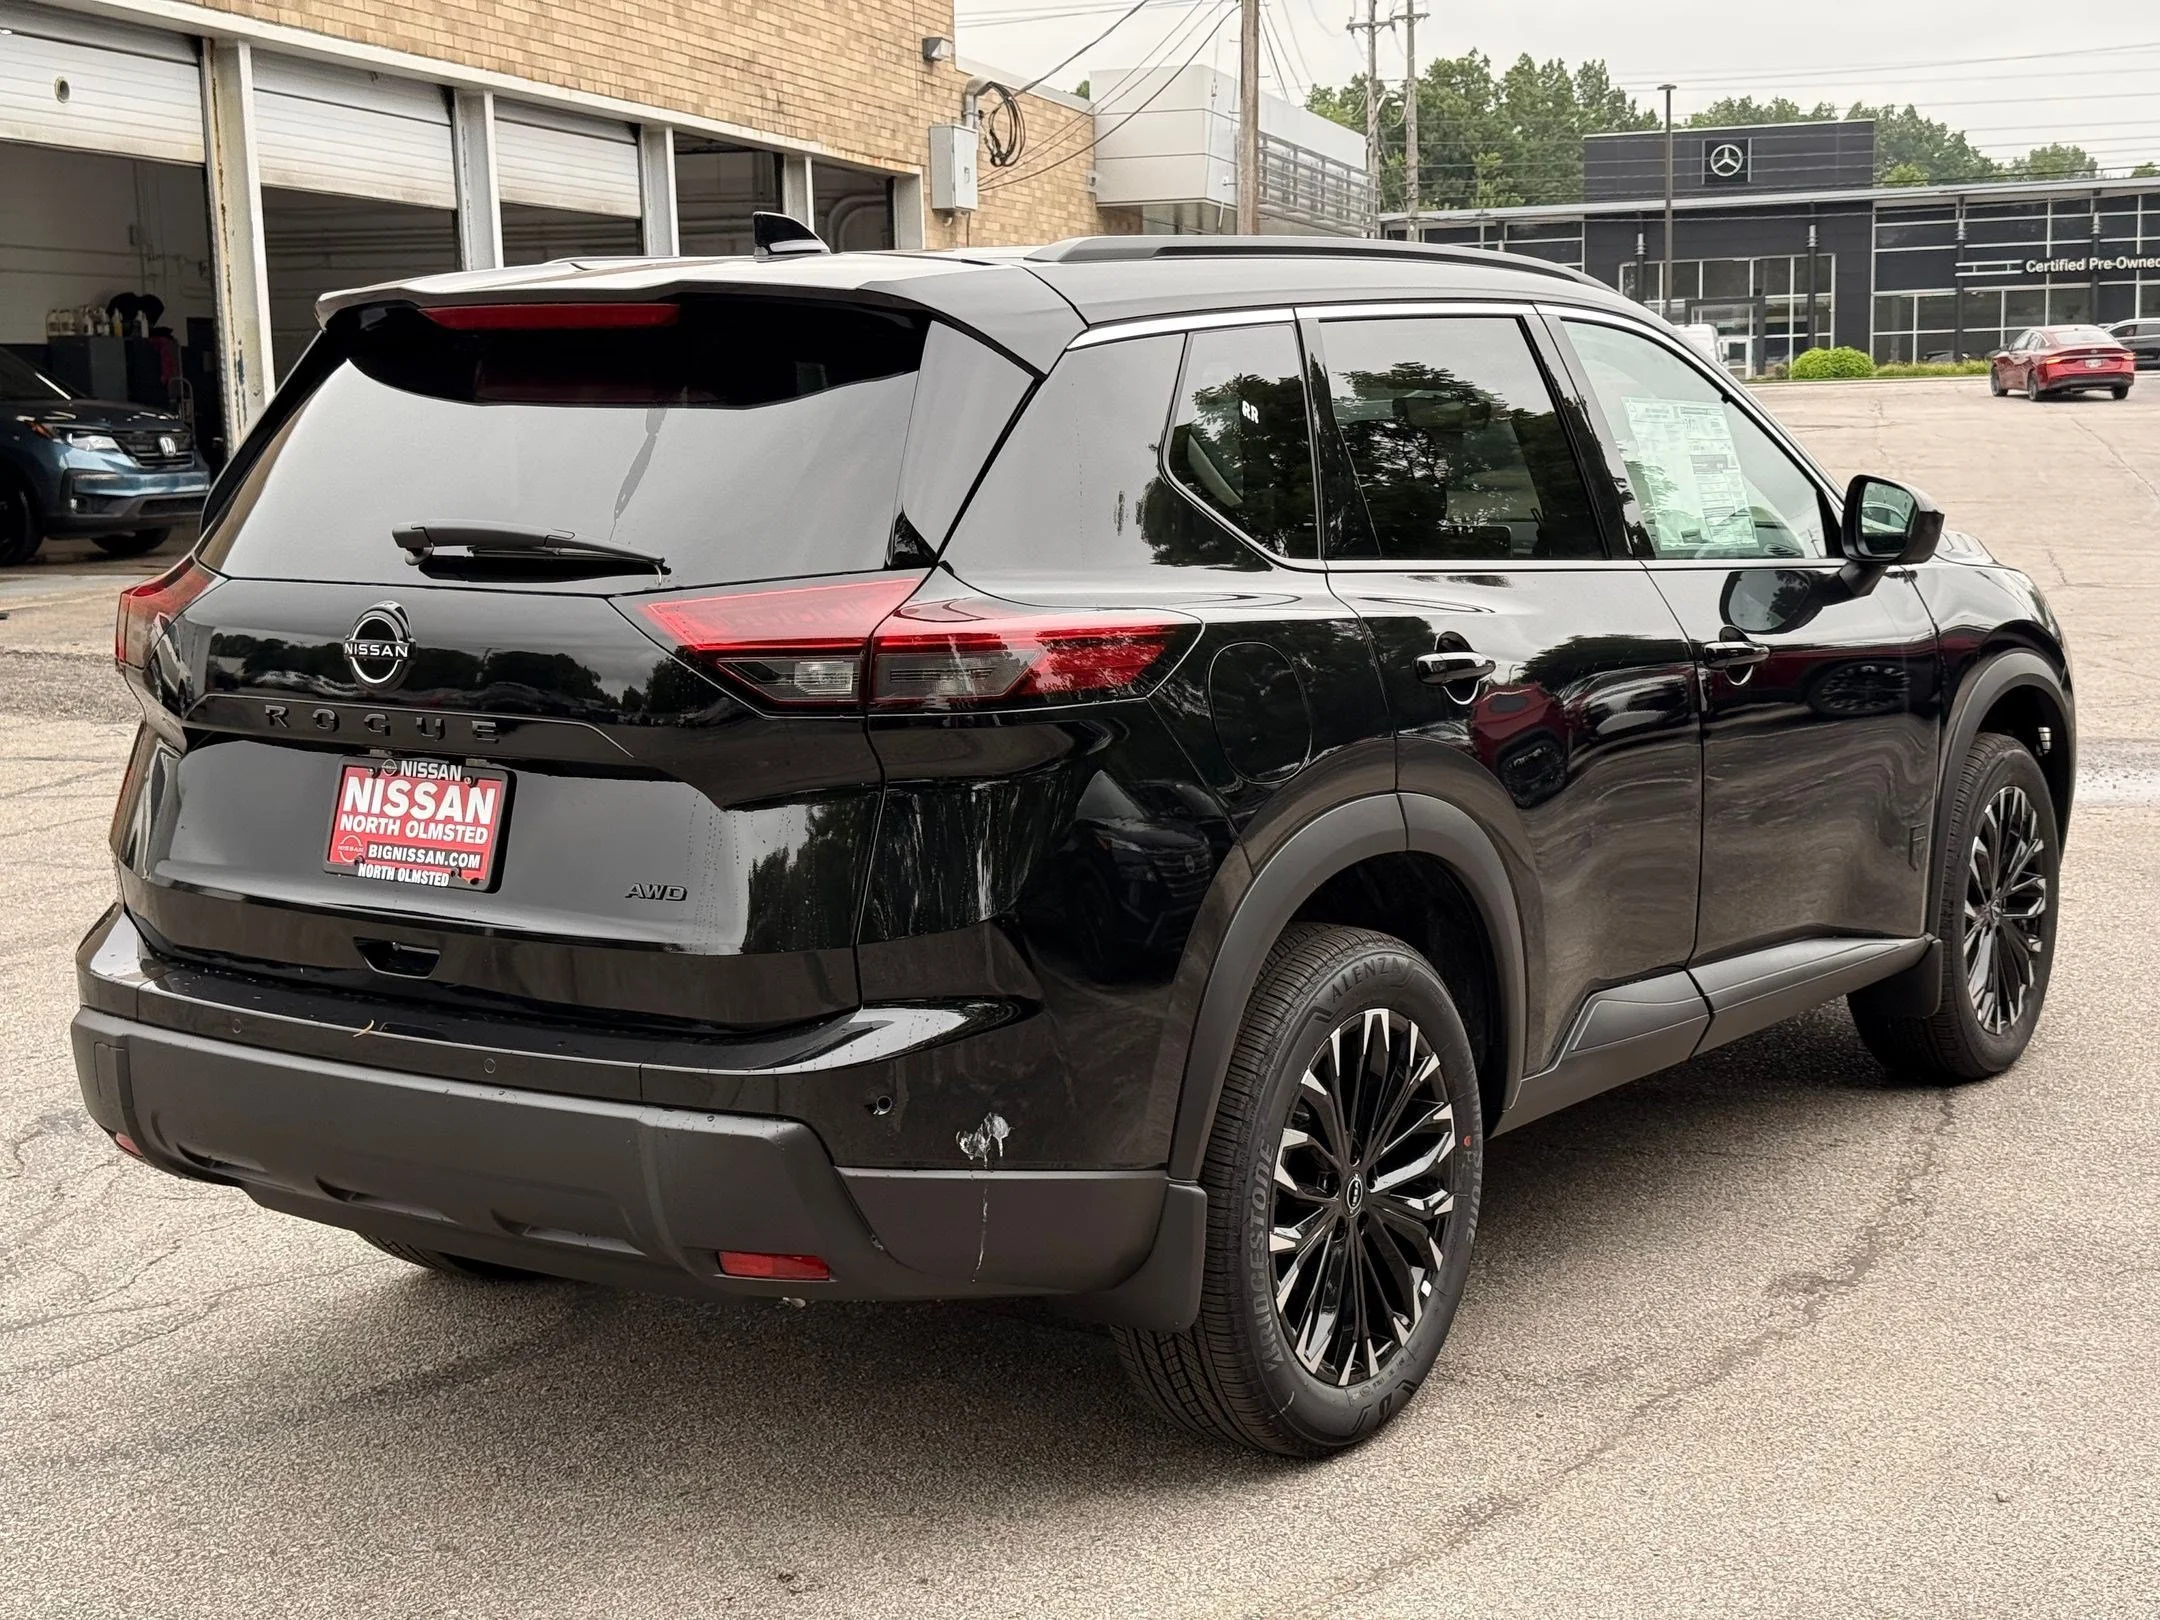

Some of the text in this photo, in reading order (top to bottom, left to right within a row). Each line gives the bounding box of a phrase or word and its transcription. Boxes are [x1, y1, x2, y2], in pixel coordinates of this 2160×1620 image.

[2025, 258, 2086, 273] Certified
[344, 642, 408, 658] NISSAN
[265, 704, 500, 743] ROGUE
[400, 760, 462, 782] NISSAN
[343, 776, 496, 825] NISSAN
[339, 813, 489, 845] NORTH OLMSTED
[368, 844, 481, 869] BIGNISSAN.COM
[357, 863, 450, 887] NORTH OLMSTED
[625, 883, 688, 901] AWD
[1330, 957, 1403, 1003] ALENZA
[1251, 1138, 1285, 1371] BRIDGESTONE
